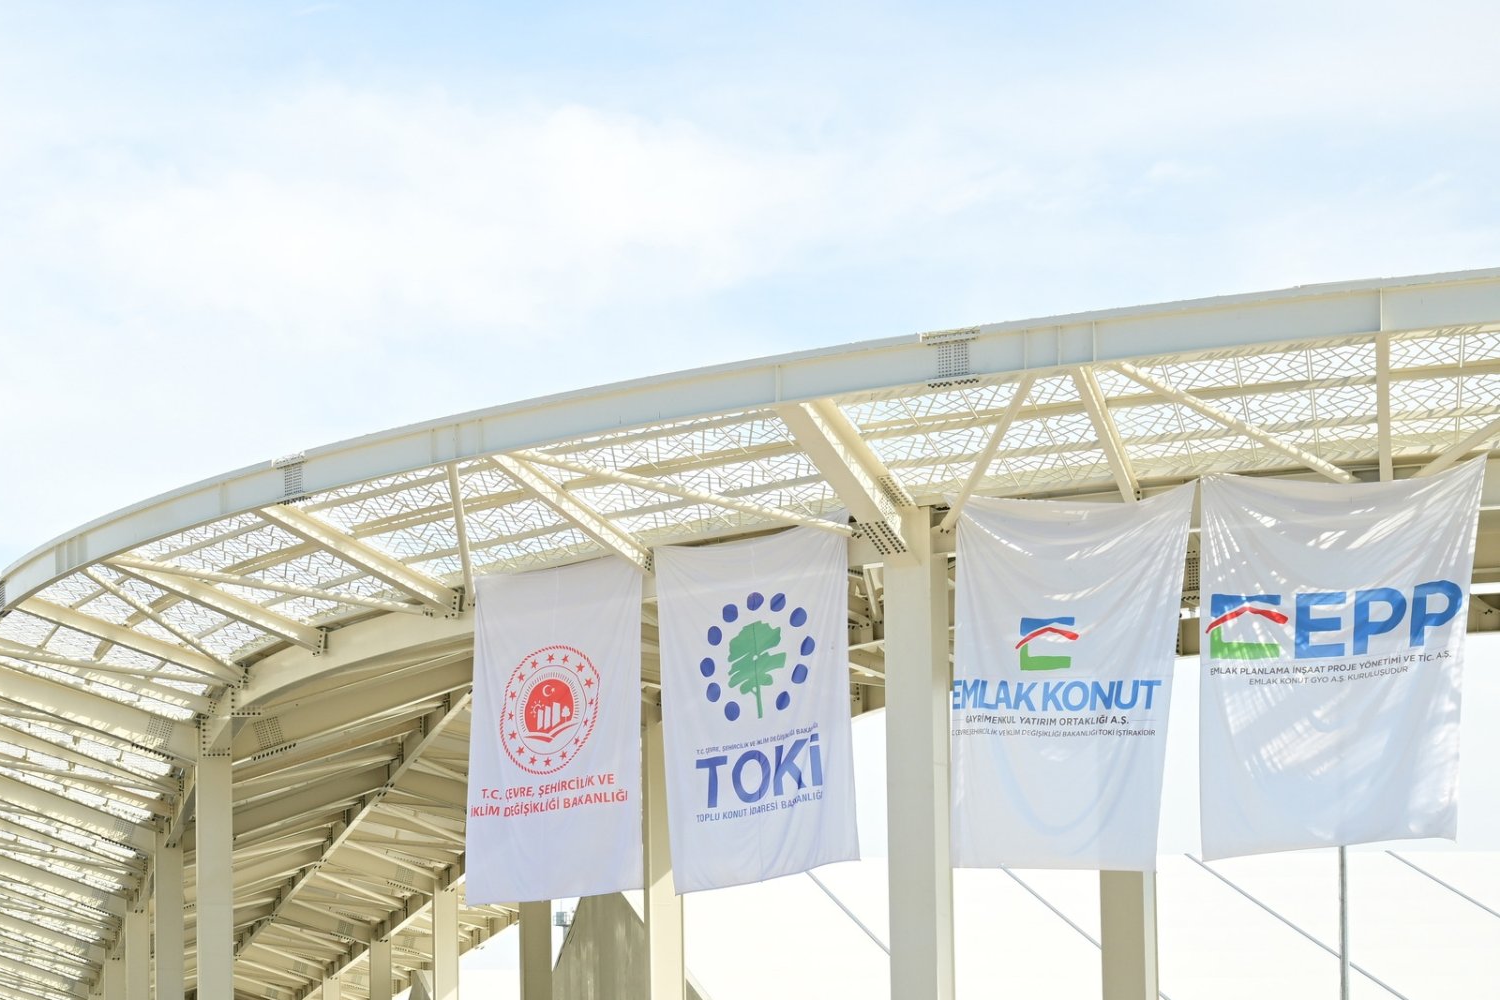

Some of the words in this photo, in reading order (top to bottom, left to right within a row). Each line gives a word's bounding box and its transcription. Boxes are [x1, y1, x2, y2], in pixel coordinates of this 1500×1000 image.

[1293, 580, 1462, 659] EPP
[1210, 666, 1238, 676] EMLAK
[1240, 666, 1290, 675] PLANLAMA
[1292, 665, 1326, 675] İNŞAAT
[1327, 663, 1357, 673] PROJE
[1359, 656, 1401, 669] YÖNETİMİ
[1404, 654, 1415, 663] VE
[1249, 678, 1278, 686] EMLAK
[1280, 677, 1308, 685] KONUT
[1310, 676, 1329, 684] GYO
[1347, 665, 1408, 681] KURULUŞUDUR
[952, 679, 1038, 712] EMLAK
[1041, 680, 1162, 712] KONUT
[1019, 716, 1057, 726] YATIRIM
[1059, 714, 1108, 726] ORTAKLIĞI
[1110, 716, 1129, 725] A.Ş.
[695, 733, 823, 808] TOKİ
[470, 803, 500, 818] İKLİM
[503, 797, 560, 818] DEĞİŞİKLİĞİ
[563, 788, 628, 810] BAKANLIĞI
[481, 788, 502, 801] T.C.
[505, 786, 534, 803] ÇEVRE,
[539, 774, 594, 799] ŞEHİRCİLİK
[598, 773, 615, 785] VE
[696, 813, 720, 823] TOPLU
[722, 808, 748, 820] KONUT
[749, 800, 778, 816] İDARESİ
